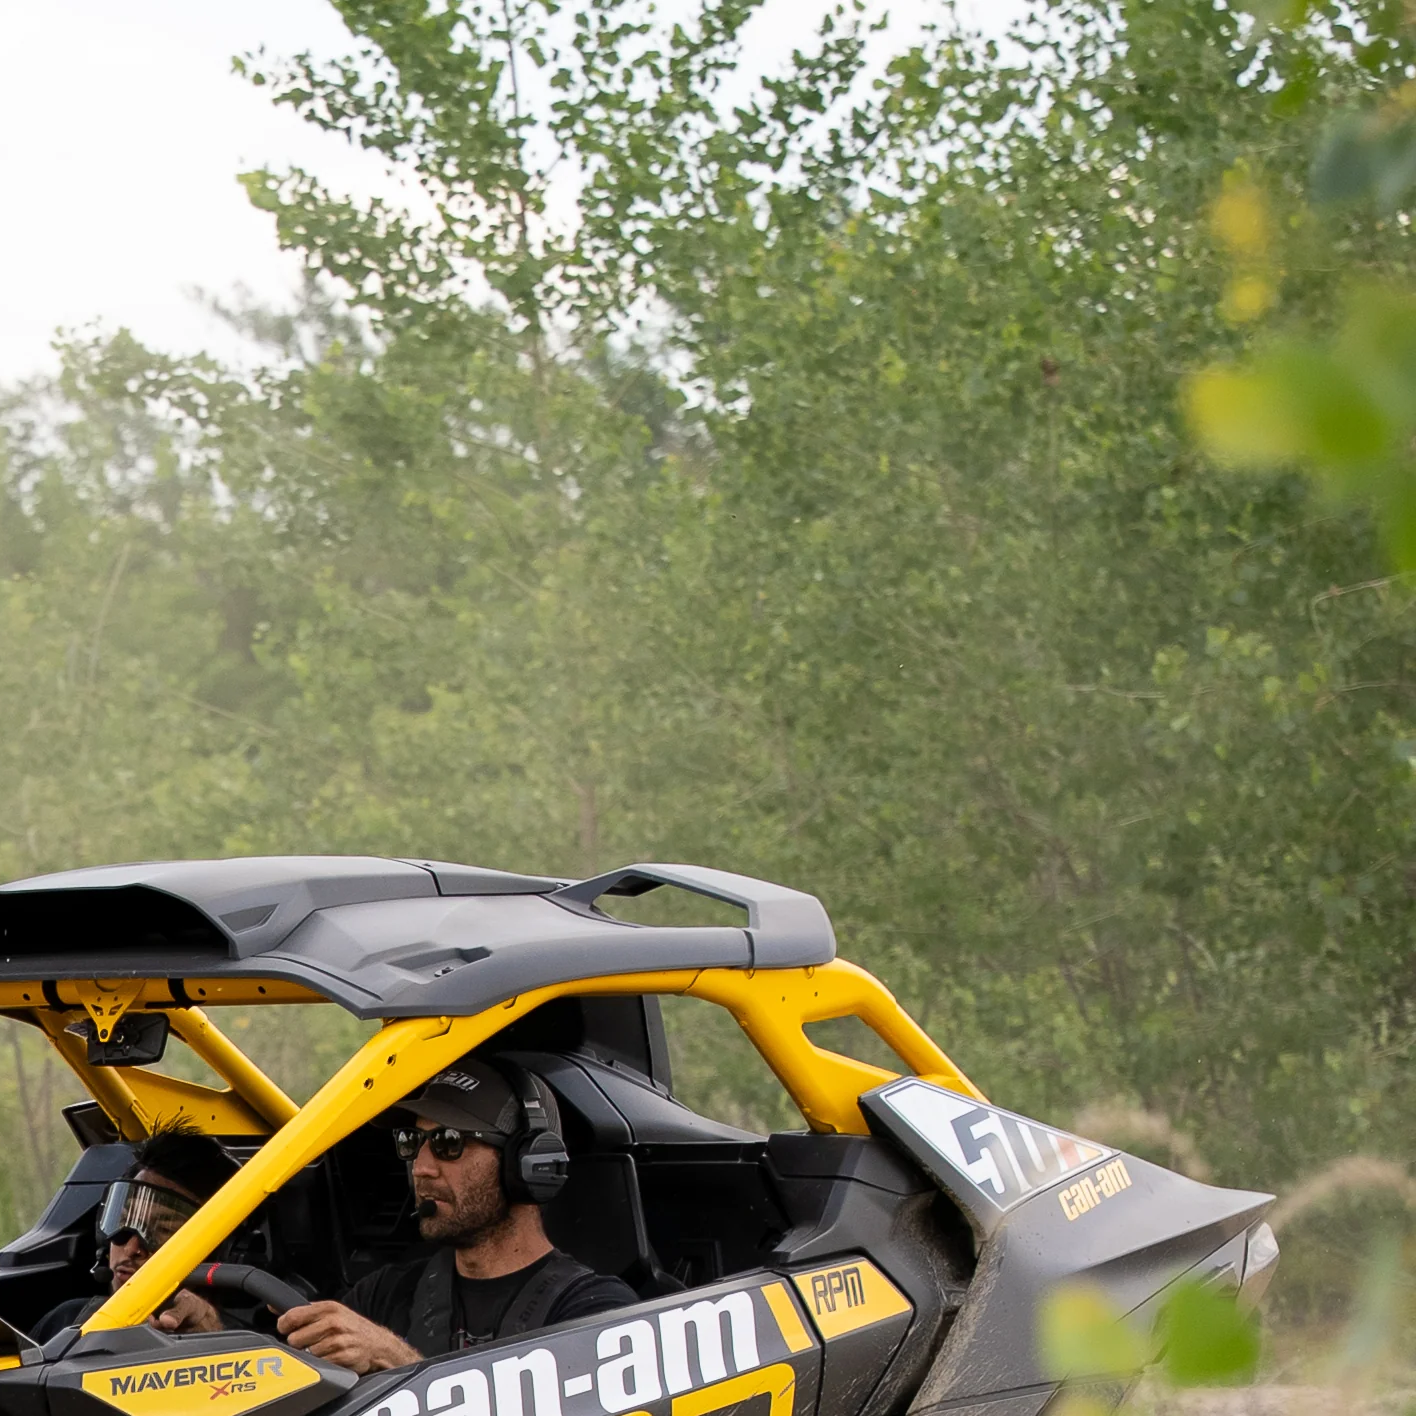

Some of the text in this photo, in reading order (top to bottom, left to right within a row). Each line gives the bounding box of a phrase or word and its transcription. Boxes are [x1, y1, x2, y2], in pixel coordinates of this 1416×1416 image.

[1058, 1158, 1133, 1221] can-am
[811, 1266, 865, 1315] RPM
[110, 1359, 253, 1396] MAVERICK
